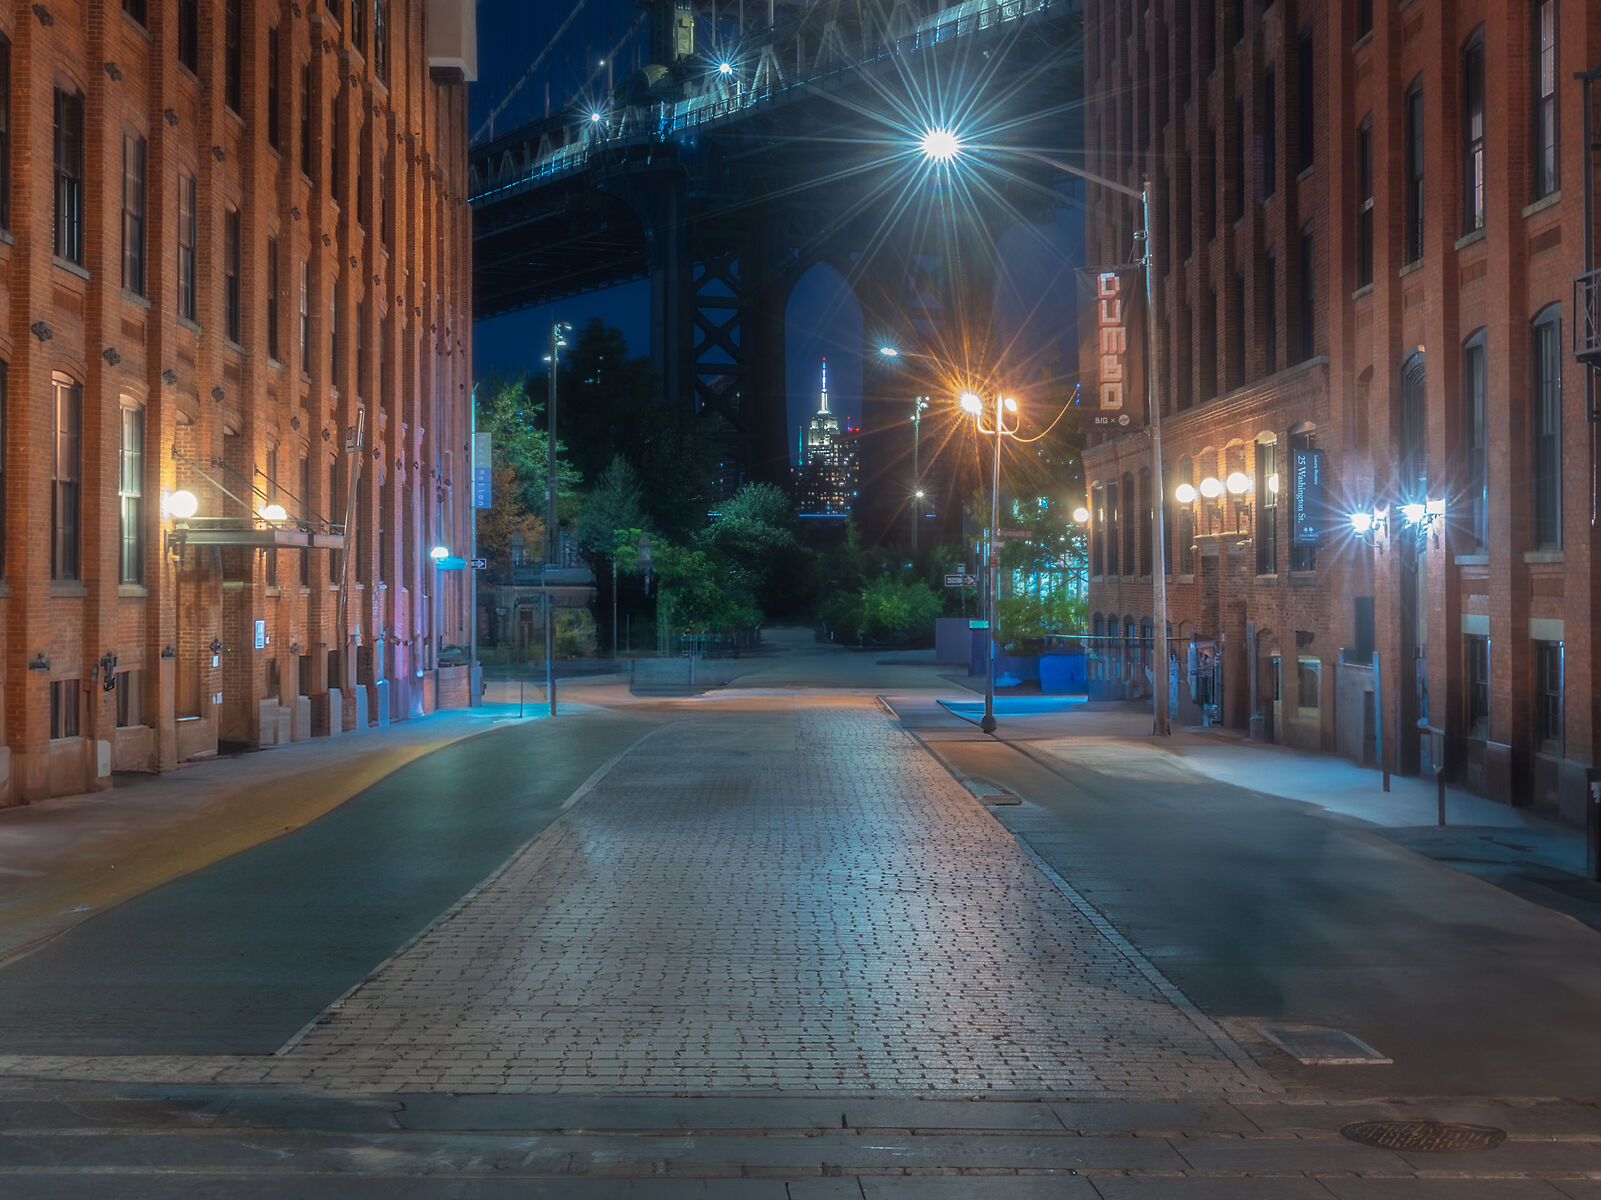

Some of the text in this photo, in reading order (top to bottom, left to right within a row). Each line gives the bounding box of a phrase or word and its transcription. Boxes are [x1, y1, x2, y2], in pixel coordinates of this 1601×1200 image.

[1098, 273, 1126, 410] DUMBO
[1296, 455, 1306, 523] 25 Washington St.
